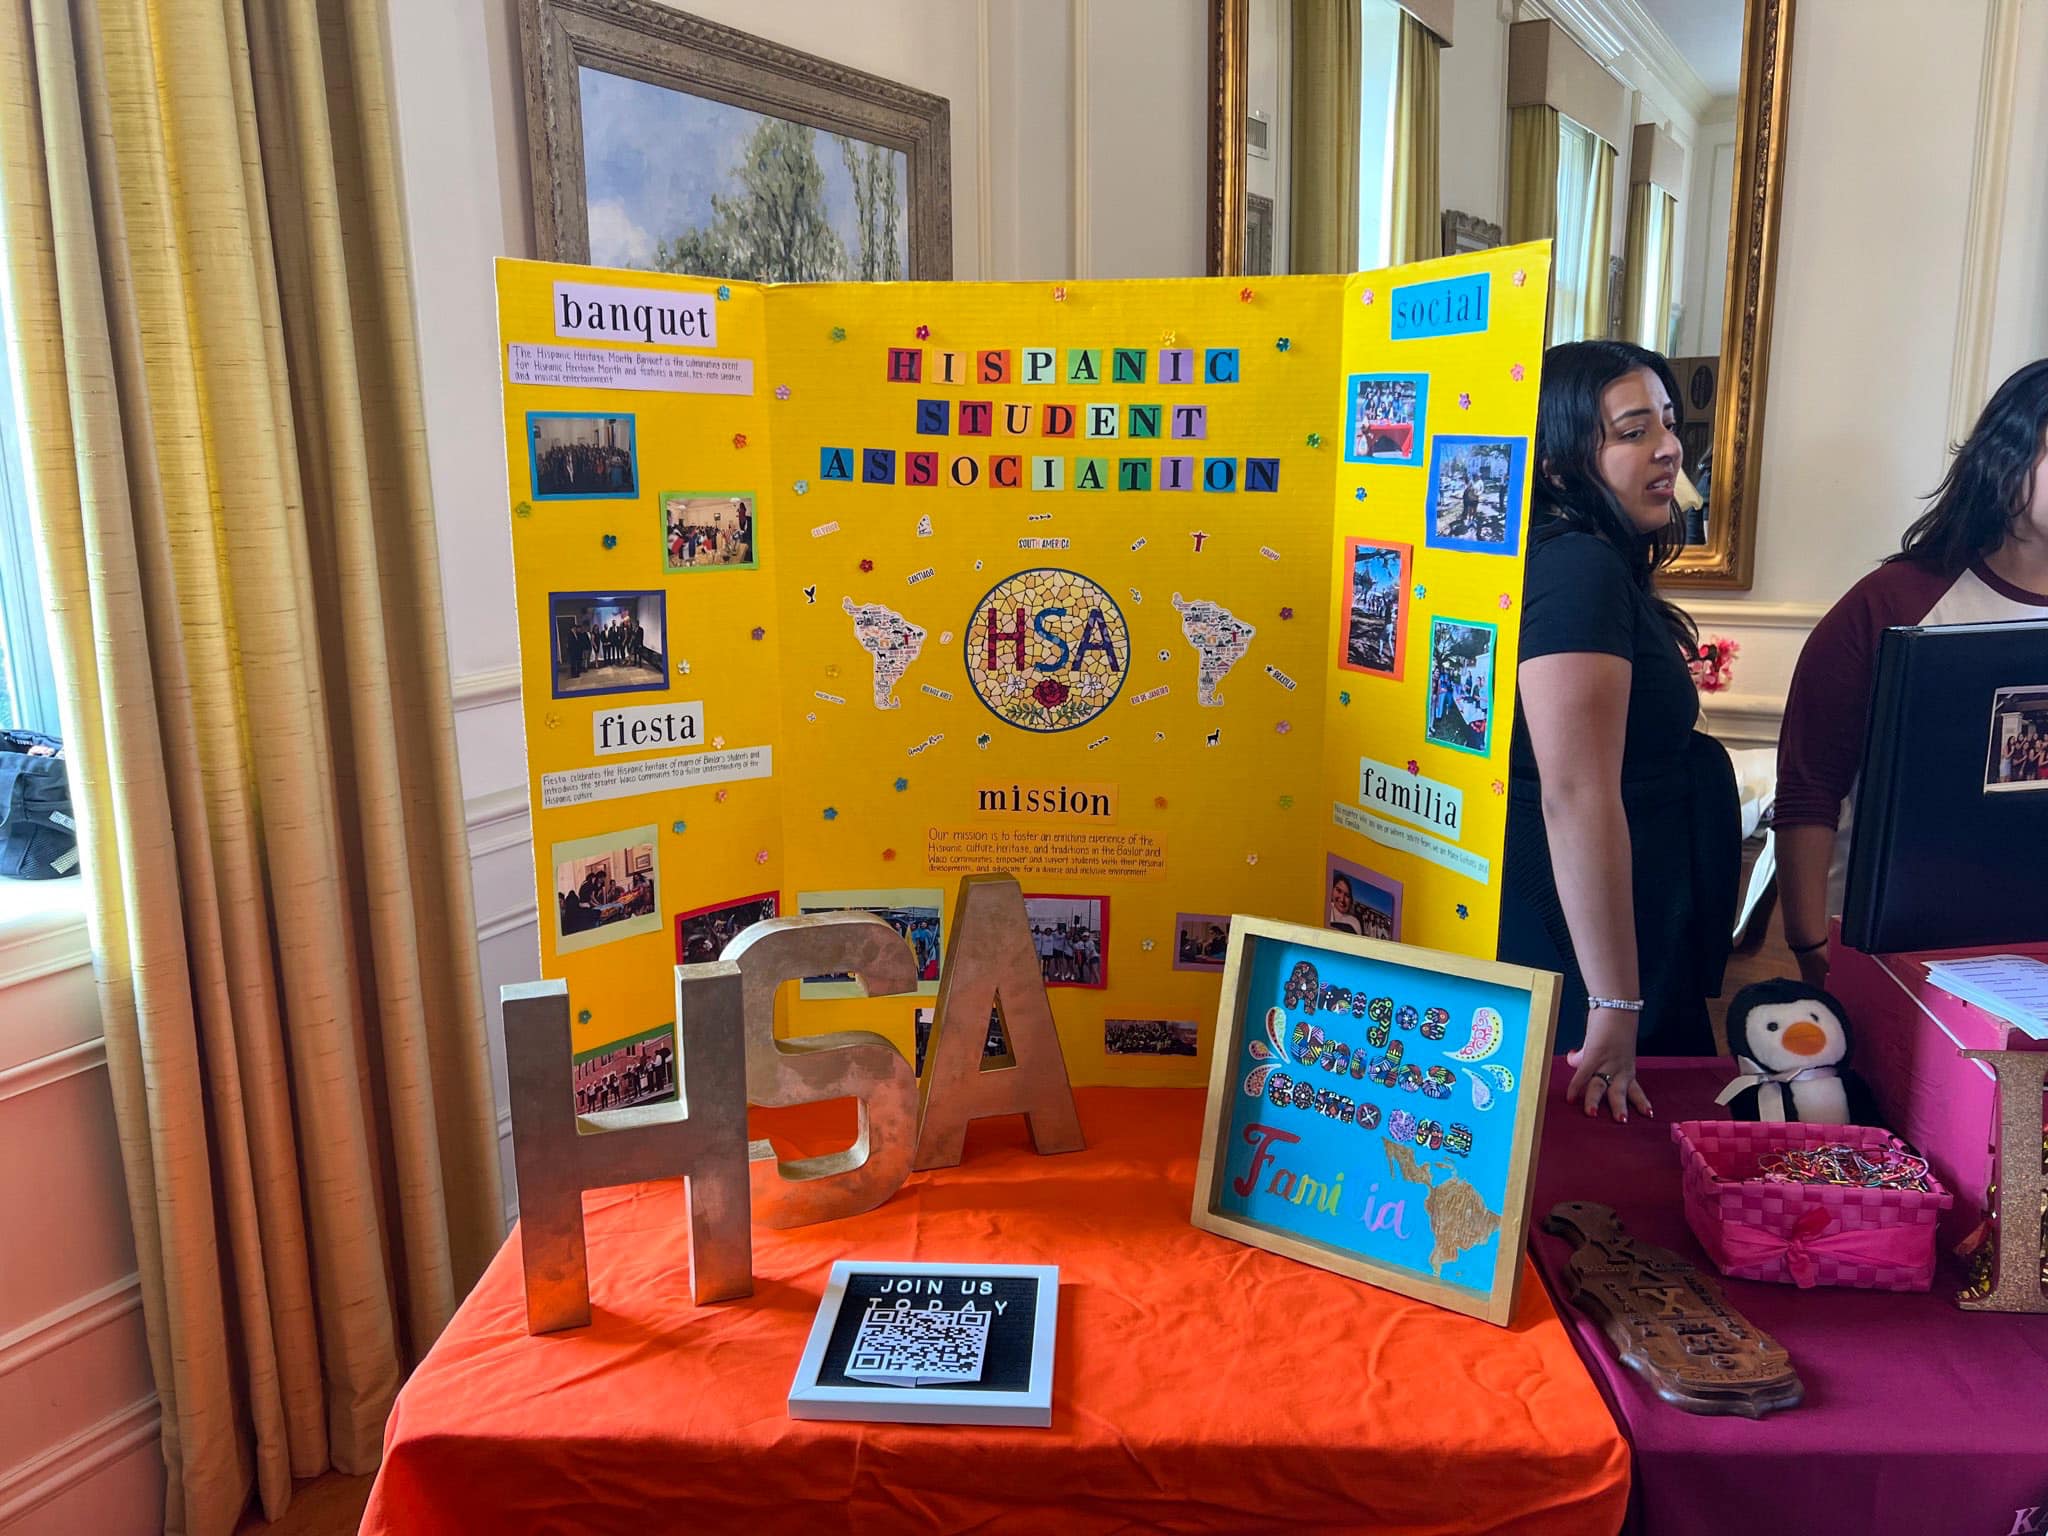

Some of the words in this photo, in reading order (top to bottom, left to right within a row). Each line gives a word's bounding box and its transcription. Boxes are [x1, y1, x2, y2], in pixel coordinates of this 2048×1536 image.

[1397, 286, 1482, 328] social
[560, 294, 710, 343] banquet
[512, 345, 531, 359] The
[537, 347, 571, 360] Hispanic
[574, 350, 604, 362] Heritage
[608, 352, 632, 364] Month
[637, 353, 663, 366] Banquet
[673, 357, 684, 366] the
[891, 350, 1232, 382] HISPANIC
[514, 371, 530, 381] and
[534, 373, 560, 382] musical
[516, 358, 529, 370] for
[534, 360, 562, 372] Hispanic
[566, 361, 595, 373] Heritage
[598, 364, 621, 375] Month
[625, 366, 636, 376] and
[640, 365, 667, 377] features
[925, 403, 1202, 437] STUDENT
[824, 449, 1278, 491] ASSOCIATION
[1019, 539, 1041, 549] SOUTH
[1042, 538, 1069, 549] AMERICA
[908, 568, 934, 584] SANTIAGO
[988, 607, 1120, 672] HSA
[600, 714, 696, 748] fiesta
[543, 775, 566, 785] Fiesta
[570, 771, 601, 783] celebrates
[604, 768, 614, 777] the
[617, 764, 643, 777] Hispanic
[670, 758, 677, 769] of
[545, 783, 578, 795] introduces
[581, 780, 591, 790] the
[594, 778, 617, 788] greater
[620, 775, 637, 785] Waco
[545, 795, 572, 805] Hispanic
[978, 785, 1110, 816] mission
[1363, 768, 1457, 828] familia
[929, 828, 948, 841] Our
[953, 831, 987, 841] mission
[992, 832, 998, 841] is
[1001, 831, 1010, 841] to
[1014, 830, 1037, 841] foster
[1054, 833, 1086, 843] enriching
[1089, 834, 1125, 845] experience
[1128, 834, 1138, 844] of
[1140, 835, 1153, 846] the
[928, 842, 962, 854] Hispanic
[1034, 845, 1048, 854] and
[1051, 846, 1089, 856] traditions
[1092, 847, 1099, 855] in
[1102, 846, 1114, 856] the
[1116, 845, 1144, 857] Baylor
[1145, 847, 1161, 858] and
[928, 854, 947, 864] Waco
[996, 856, 1025, 865] empower
[1029, 856, 1042, 864] and
[1045, 857, 1068, 866] support
[1072, 856, 1099, 865] students
[1101, 857, 1117, 866] with
[1120, 858, 1136, 866] their
[1138, 859, 1164, 868] personal
[976, 865, 989, 873] and
[992, 866, 1020, 874] advocate
[1042, 866, 1062, 874] diverse
[1066, 867, 1078, 875] and
[1080, 867, 1107, 876] inclusive
[1284, 960, 1449, 1047] Amigos
[1290, 1021, 1456, 1100] Unidos
[881, 1279, 943, 1294] JOIN
[962, 1280, 993, 1295] US
[868, 1297, 1008, 1315] TODAY
